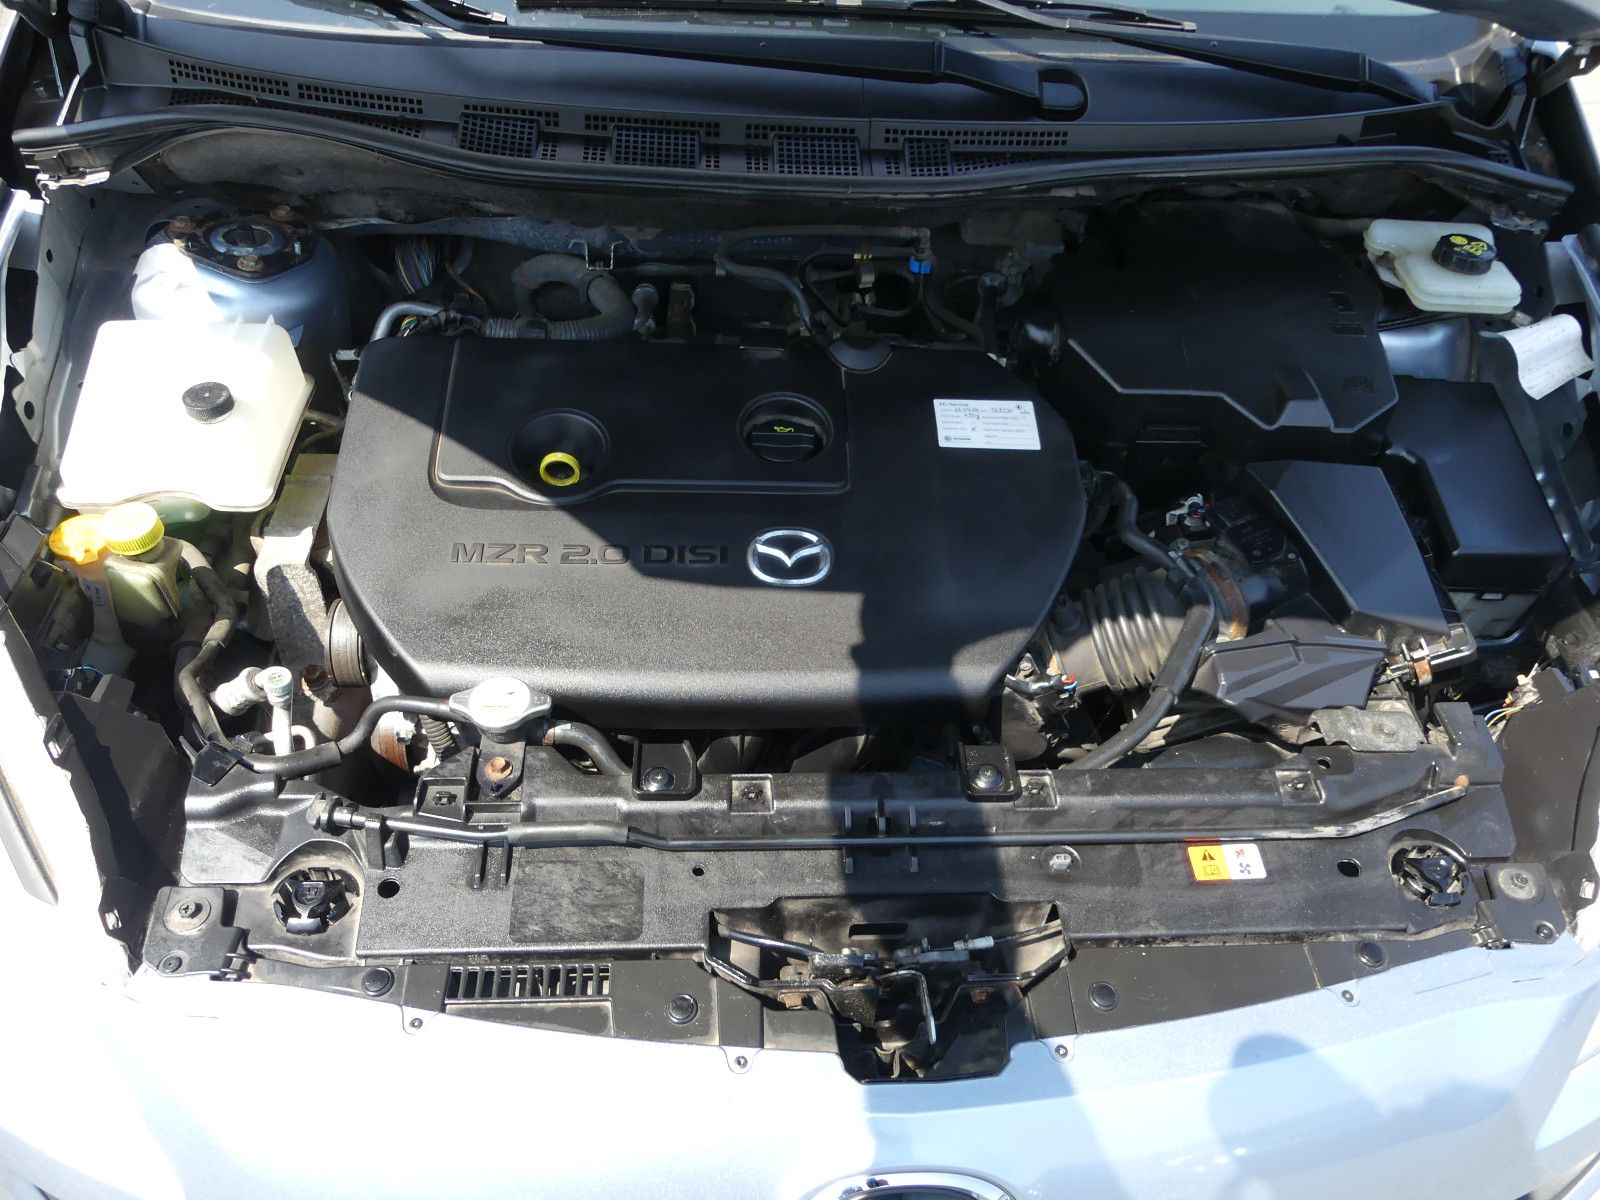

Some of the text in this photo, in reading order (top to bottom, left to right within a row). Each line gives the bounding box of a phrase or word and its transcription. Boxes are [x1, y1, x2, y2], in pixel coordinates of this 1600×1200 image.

[450, 542, 729, 566] MZR 2.0 DISI
